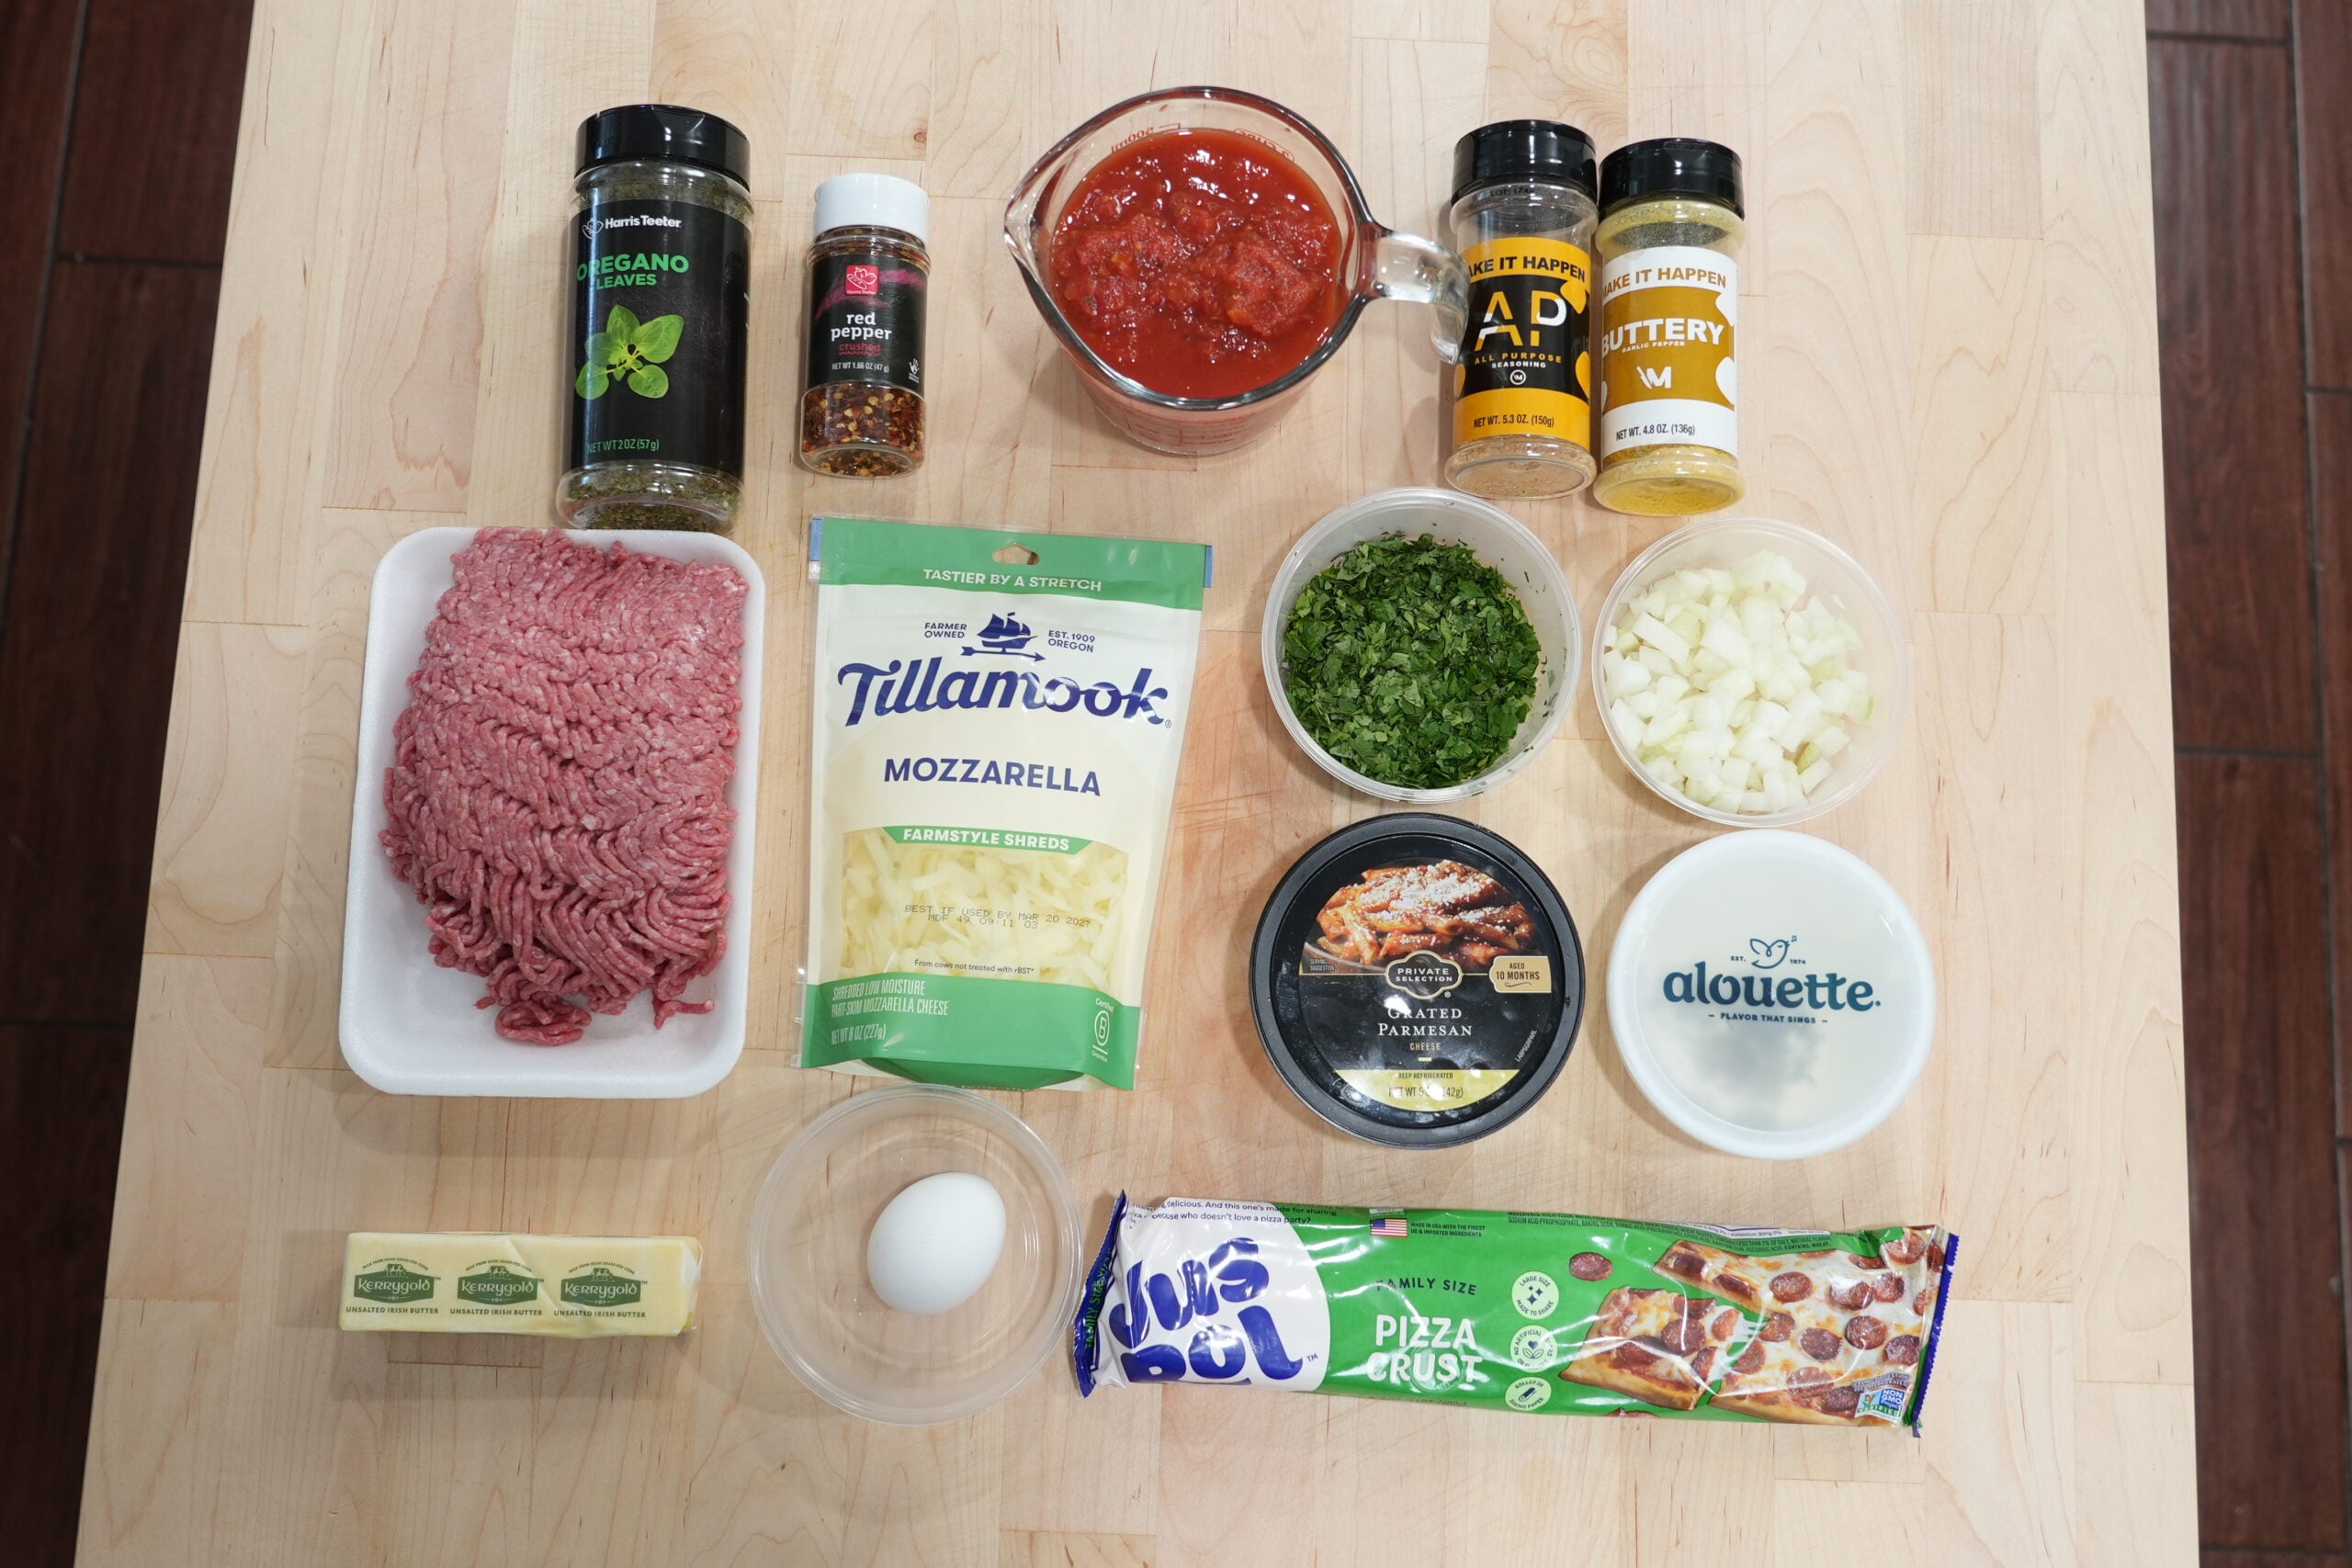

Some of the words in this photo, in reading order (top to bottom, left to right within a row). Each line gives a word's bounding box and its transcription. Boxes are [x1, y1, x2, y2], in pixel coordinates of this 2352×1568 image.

[605, 216, 640, 230] Harris
[640, 214, 683, 229] Teeter
[576, 253, 690, 282] OREGANO
[1468, 258, 1494, 277] KE
[1499, 255, 1518, 270] IT
[1522, 255, 1586, 283] HAPPEN
[595, 273, 657, 290] LEAVES
[1635, 268, 1652, 284] IT
[1657, 267, 1726, 288] HAPPEN
[846, 311, 876, 325] red
[1474, 289, 1567, 353] AP
[831, 326, 893, 342] pepper
[1601, 317, 1725, 359] BUTTERY
[839, 342, 882, 352] crushed
[831, 362, 842, 370] NET
[842, 362, 852, 370] WT
[865, 362, 874, 370] OZ
[1474, 354, 1495, 365] ALL
[1501, 352, 1562, 364] PURPOSE
[1491, 360, 1546, 369] SEASONING
[1474, 416, 1487, 429] NET
[1487, 414, 1500, 425] WT.
[1502, 414, 1515, 424] 5.3
[1516, 413, 1529, 424] OZ.
[1531, 414, 1555, 428] (150g)
[1616, 429, 1627, 441] NET
[1628, 426, 1642, 437] WT.
[1643, 424, 1655, 434] 4.8
[1656, 423, 1669, 434] OZ.
[1670, 423, 1695, 435] (136g)
[588, 441, 602, 454] NET
[603, 439, 618, 451] WT
[617, 439, 623, 450] 2
[624, 438, 637, 449] OZ
[923, 569, 986, 585] TASTIER
[989, 573, 1011, 585] BY
[1013, 575, 1024, 587] A
[1028, 576, 1102, 592] STRETCH
[924, 622, 967, 631] FARMER
[924, 630, 965, 638] OWNED
[1048, 629, 1069, 639] EST.
[1071, 632, 1096, 643] 1909
[1047, 638, 1094, 653] OREGON
[837, 656, 1169, 728] Tillamook
[883, 756, 1102, 797] MOZZARELLA
[902, 828, 1000, 846] FARMSTYLE
[1004, 832, 1070, 852] SHREDS
[905, 904, 933, 914] BEST
[942, 907, 956, 915] IF
[961, 908, 990, 918] USED
[997, 910, 1012, 919] BY
[1018, 912, 1039, 921] MAR
[1046, 914, 1059, 923] 20
[914, 959, 933, 968] From
[968, 964, 996, 972] treated
[997, 965, 1013, 974] with
[1397, 967, 1450, 976] PRIVATE
[1496, 971, 1505, 980] 10
[1507, 971, 1540, 980] MONTHS
[832, 982, 865, 1001] SHREDDED
[865, 980, 882, 996] LOW
[881, 978, 926, 996] MOISTURE
[831, 998, 864, 1019] PART-SKIM
[863, 997, 914, 1013] MOZZARELLA
[916, 998, 949, 1016] CHEESE
[1720, 1012, 1758, 1021] FLAVOR
[1760, 1014, 1785, 1022] THAT
[1787, 1015, 1816, 1023] SINGS
[1377, 1022, 1473, 1037] PARMESAN
[1409, 1042, 1442, 1051] CHEESE
[1406, 1087, 1417, 1097] WT
[1181, 1211, 1199, 1220] who
[1200, 1212, 1232, 1221] doesn't
[1234, 1213, 1252, 1222] love
[1261, 1214, 1282, 1223] pizza
[1283, 1216, 1312, 1224] party?
[1242, 1203, 1264, 1212] one's
[1306, 1208, 1338, 1217] sharing
[1375, 1277, 1436, 1292] FAMILY
[1442, 1279, 1477, 1296] SIZE
[1520, 1275, 1537, 1287] LARGE
[1538, 1276, 1551, 1288] SIZE
[1090, 1280, 1103, 1304] SIZE
[1516, 1299, 1529, 1315] MADE
[1538, 1300, 1555, 1316] SHARE
[1084, 1307, 1099, 1348] FAMILY
[1375, 1314, 1477, 1350] PIZZA
[1515, 1329, 1543, 1346] ARTIFICIAL
[1513, 1346, 1520, 1356] NO
[1365, 1351, 1484, 1383] CRUST
[1881, 1394, 1902, 1404] GMO
[1883, 1389, 1903, 1398] NON
